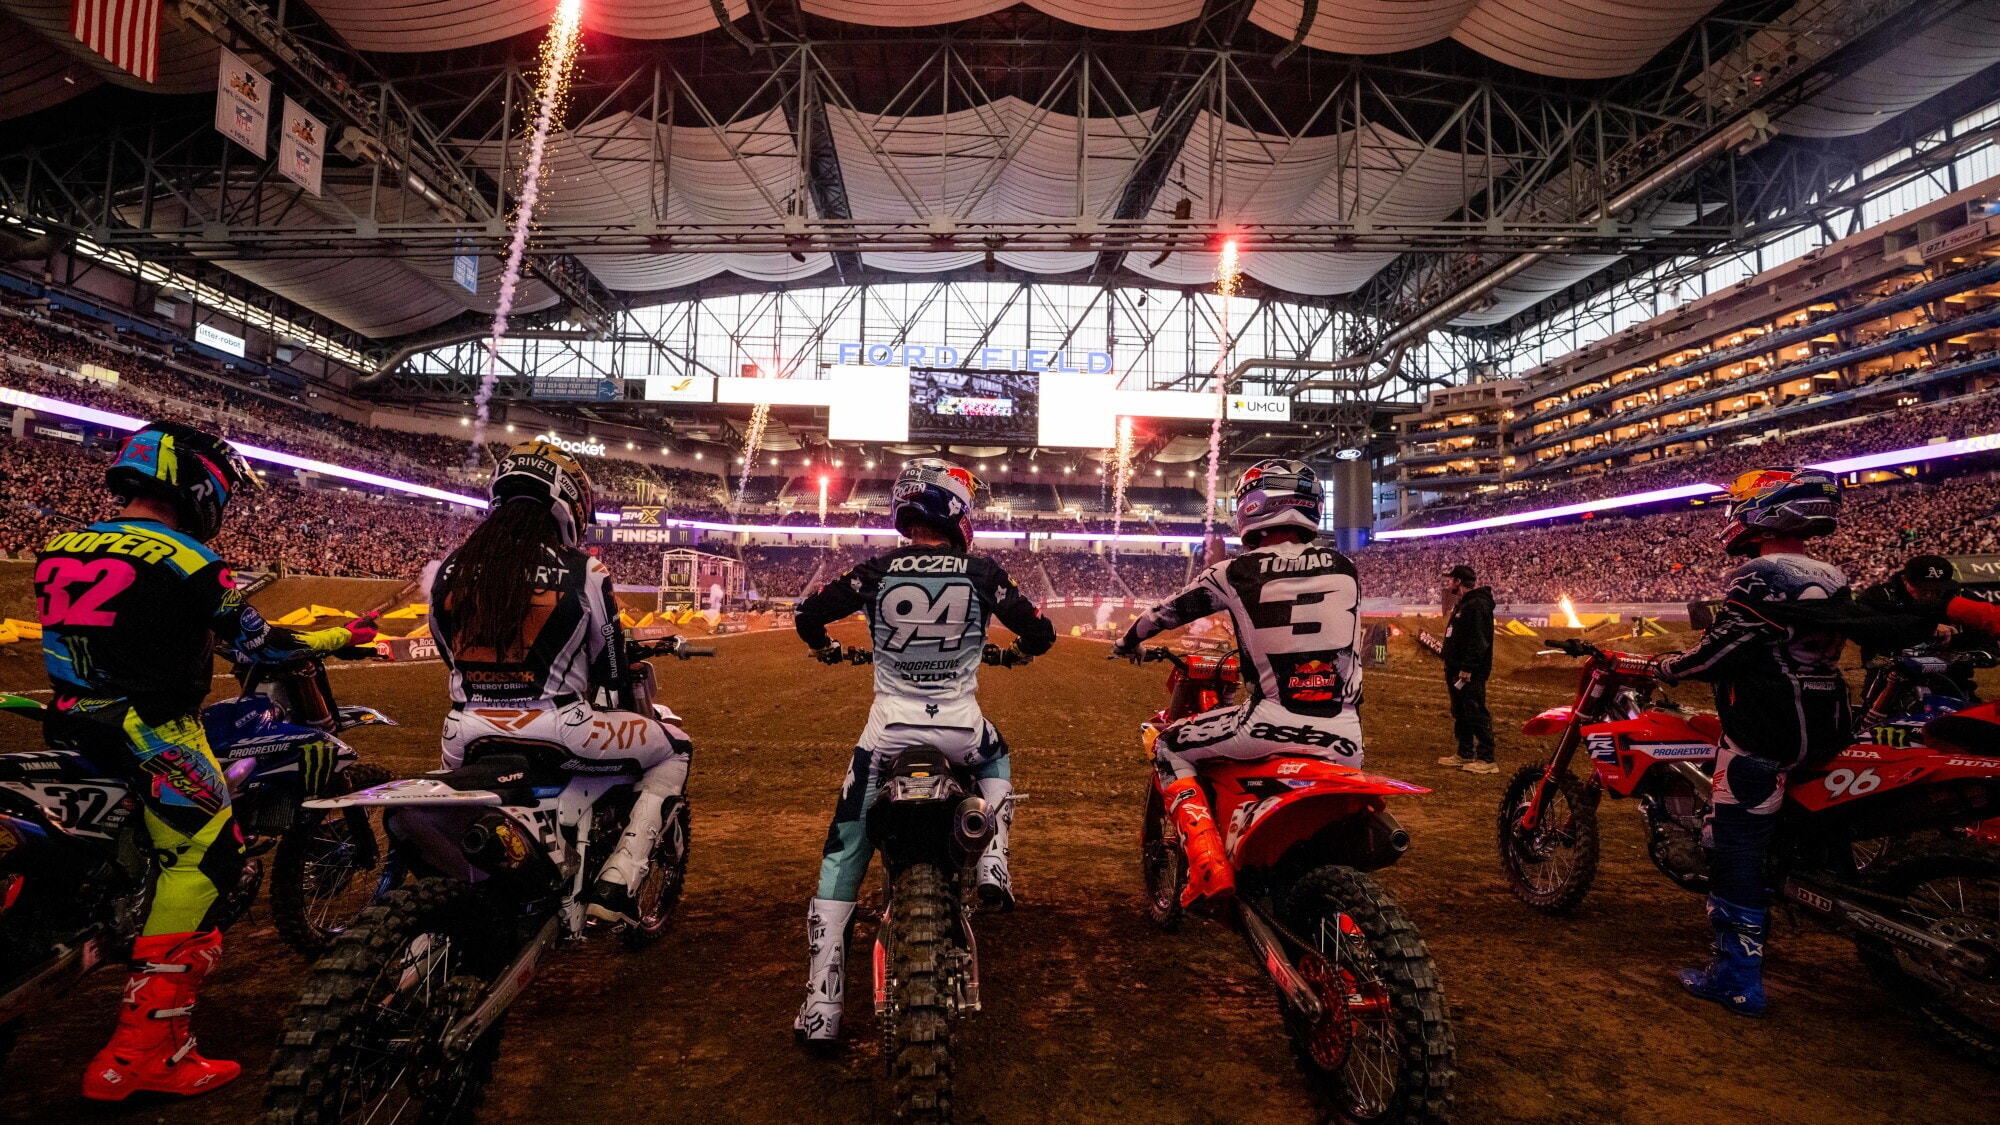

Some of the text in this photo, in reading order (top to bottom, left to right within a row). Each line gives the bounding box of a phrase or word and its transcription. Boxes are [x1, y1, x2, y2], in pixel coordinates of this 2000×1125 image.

[838, 342, 1113, 375] FORD FIELD
[1247, 401, 1285, 413] UMCU
[550, 435, 606, 457] Rocket
[517, 456, 558, 476] RIVELL
[559, 476, 578, 498] SHOEI
[620, 509, 661, 524] SMX
[1245, 502, 1260, 514] BELL
[611, 529, 671, 543] FINISH
[42, 531, 174, 566] OOPER
[886, 555, 969, 574] ROCZEN
[1258, 552, 1334, 574] TOMAC
[34, 557, 137, 627] 32
[881, 582, 977, 653] 94
[1251, 573, 1358, 655] 3
[605, 635, 619, 679] Husqvarna
[894, 656, 962, 672] PROGRESSIVE
[465, 670, 536, 683] ROCKSTAR
[901, 671, 958, 683] SUZUKI
[1288, 674, 1337, 688] Red Bull
[471, 682, 530, 691] ENERGY DRINK
[582, 718, 648, 751] FXR
[1250, 722, 1358, 758] astars
[228, 743, 291, 759] PROGRESSIVE
[1652, 747, 1713, 757] PROGRESSIVE
[18, 761, 62, 771] YAMAHA
[496, 771, 525, 784] GUTS
[1823, 767, 1882, 800] 96
[44, 786, 108, 833] 32
